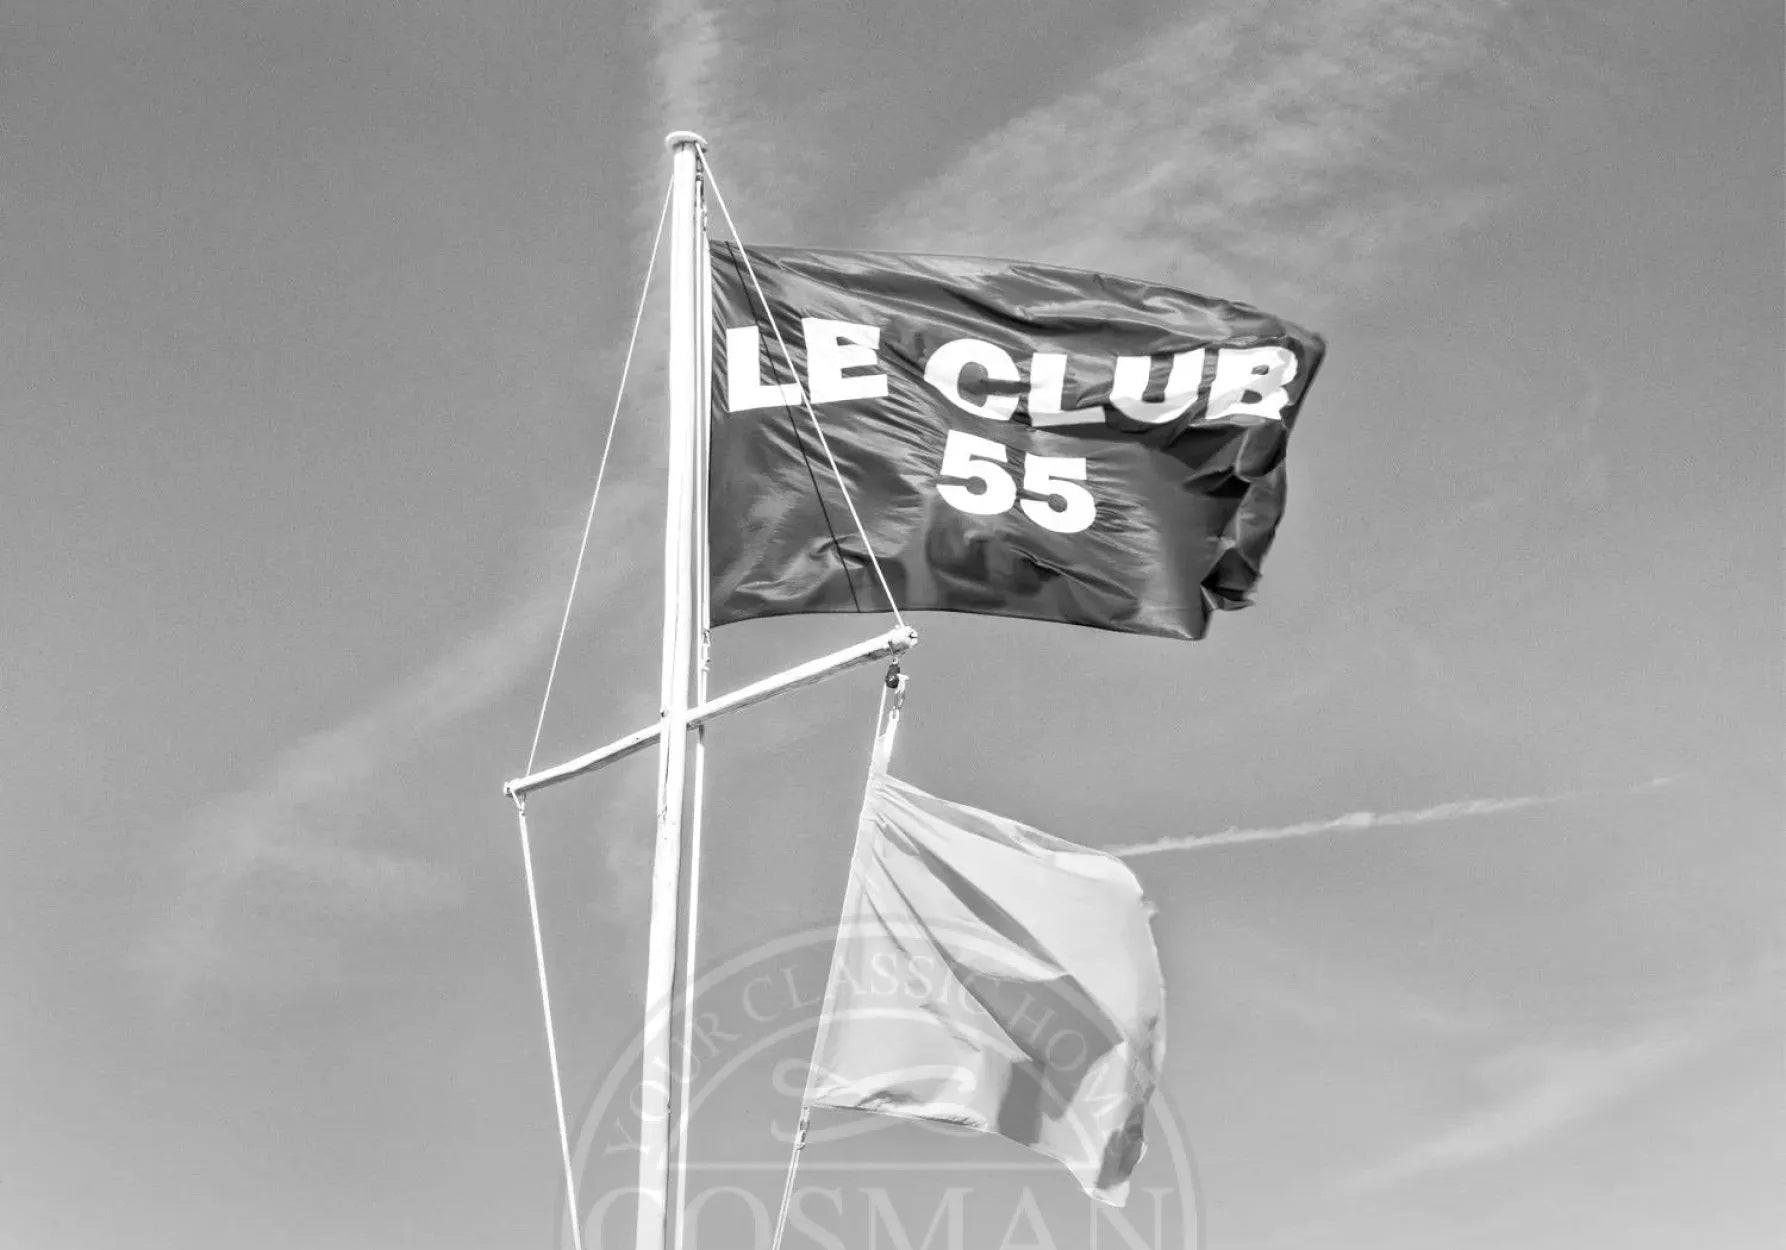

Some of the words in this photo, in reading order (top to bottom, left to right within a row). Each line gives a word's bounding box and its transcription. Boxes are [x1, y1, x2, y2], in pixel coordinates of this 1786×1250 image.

[725, 317, 889, 412] LE
[923, 337, 1299, 427] CLUB
[936, 428, 1097, 534] 55
